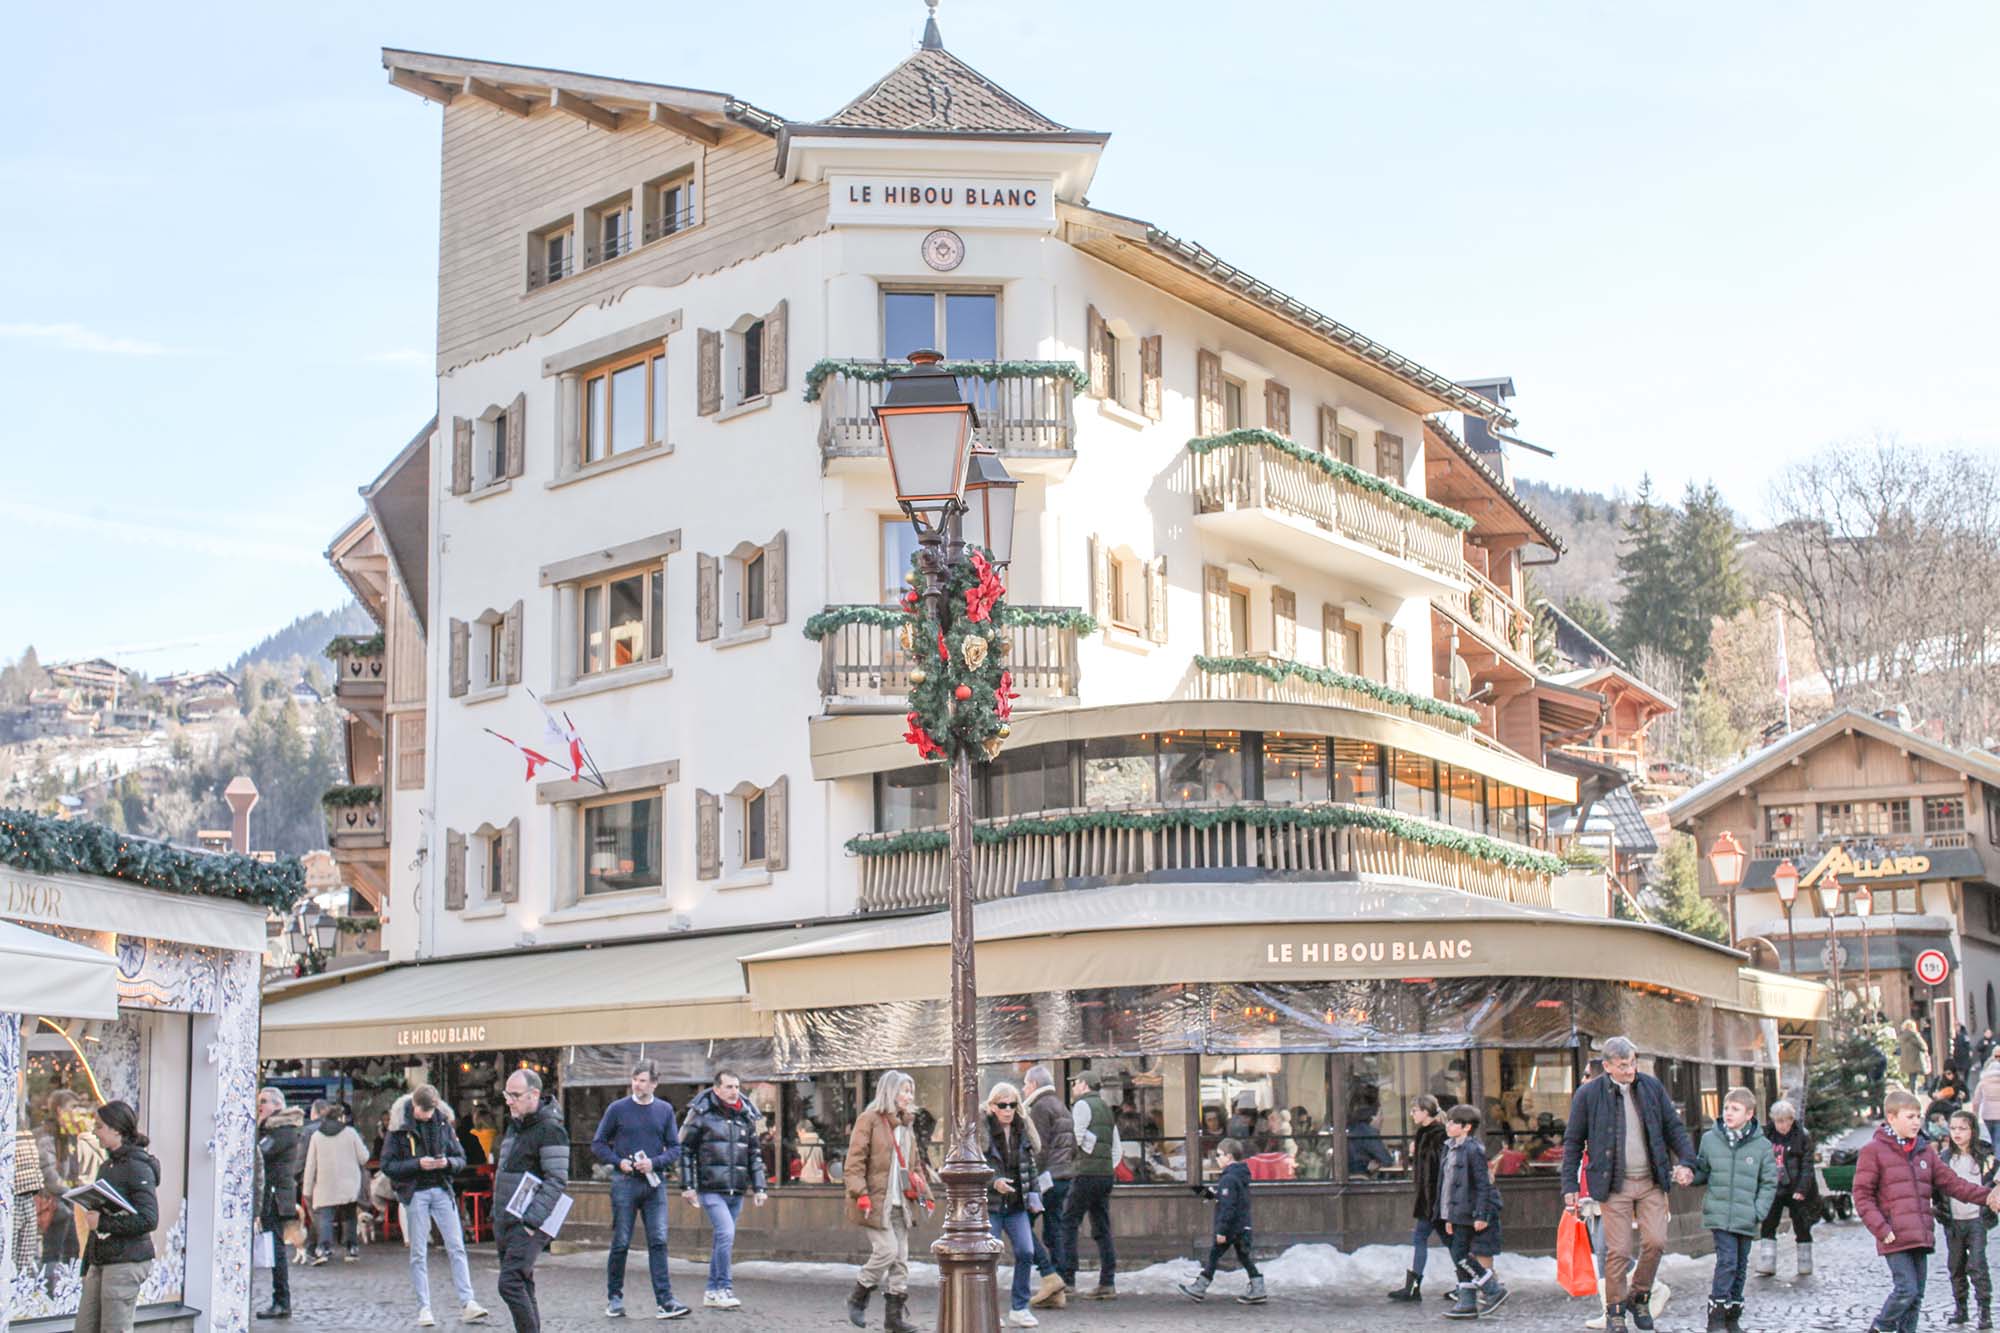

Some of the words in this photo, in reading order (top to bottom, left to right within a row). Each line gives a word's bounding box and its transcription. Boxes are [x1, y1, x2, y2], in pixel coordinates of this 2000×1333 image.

[850, 185, 872, 203] LE
[885, 186, 953, 205] HIBOU
[966, 188, 1036, 206] BLANC
[7, 880, 62, 918] DIOR
[1267, 943, 1292, 962] LE
[1302, 942, 1385, 962] HIBOU
[1392, 939, 1473, 960] BLANC
[398, 1031, 409, 1045] LE
[411, 1028, 446, 1044] HIBOU
[448, 1025, 486, 1043] BLANC
